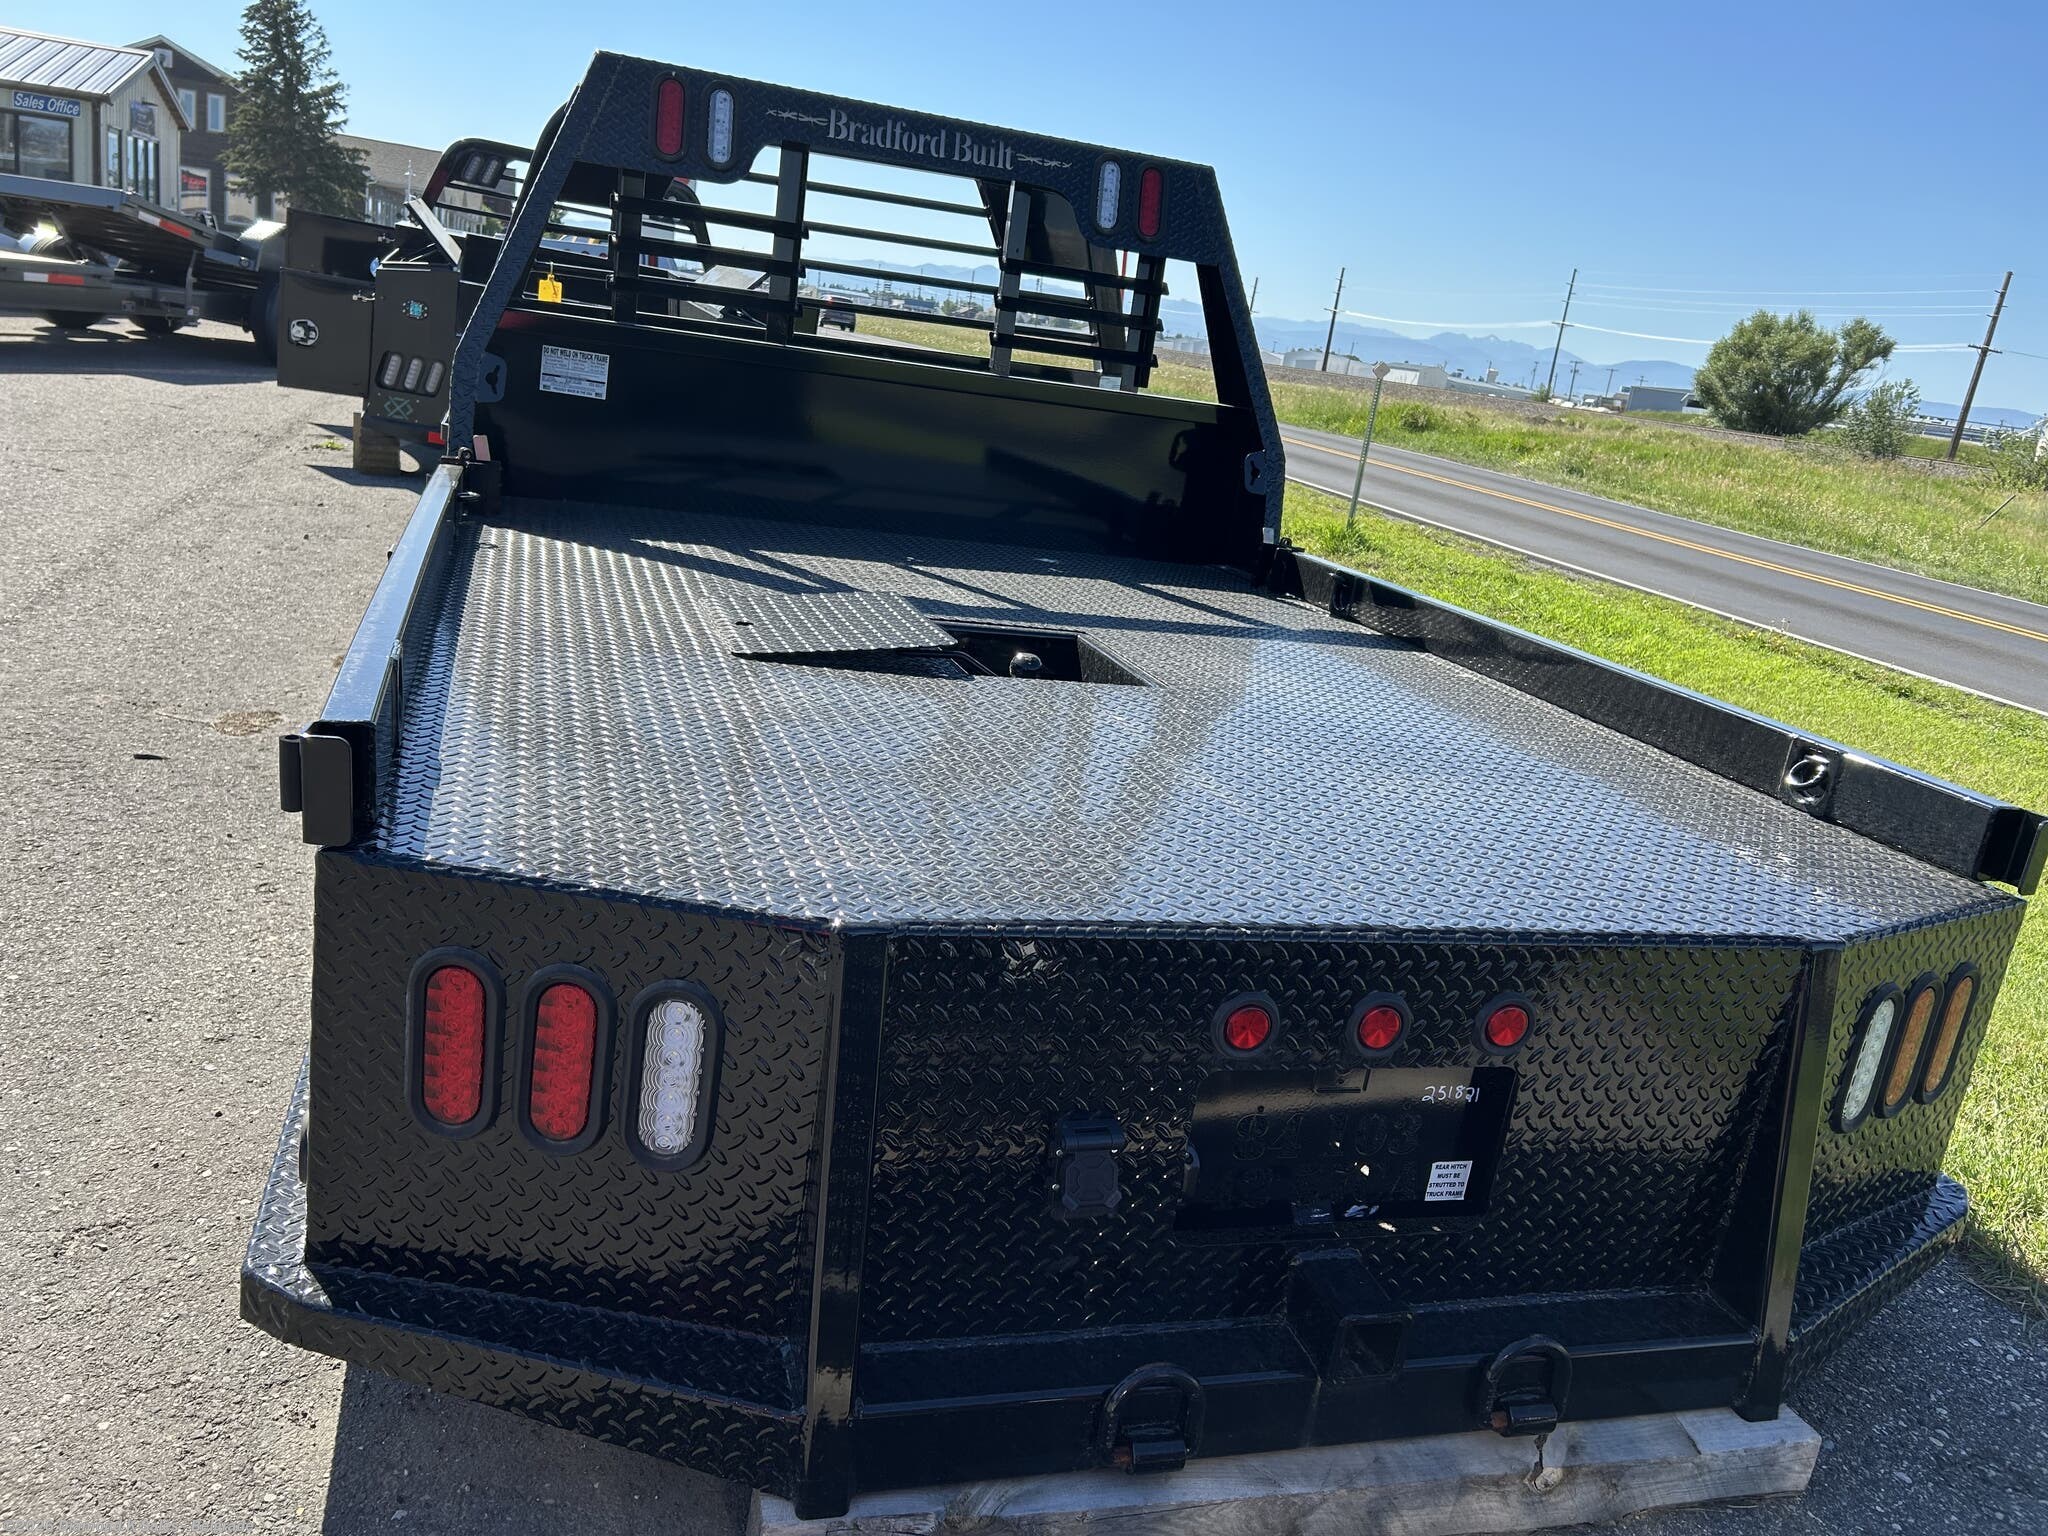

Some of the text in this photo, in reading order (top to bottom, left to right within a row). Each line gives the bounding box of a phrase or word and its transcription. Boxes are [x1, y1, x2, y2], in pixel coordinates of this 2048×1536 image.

[15, 93, 80, 115] Sales Office
[827, 109, 1015, 170] Bradford Built
[551, 347, 559, 355] NOT
[560, 348, 571, 357] WELD
[572, 350, 578, 358] ON
[579, 351, 593, 360] TRUCK
[594, 353, 608, 363] FRAME
[1421, 1085, 1480, 1103] 251821
